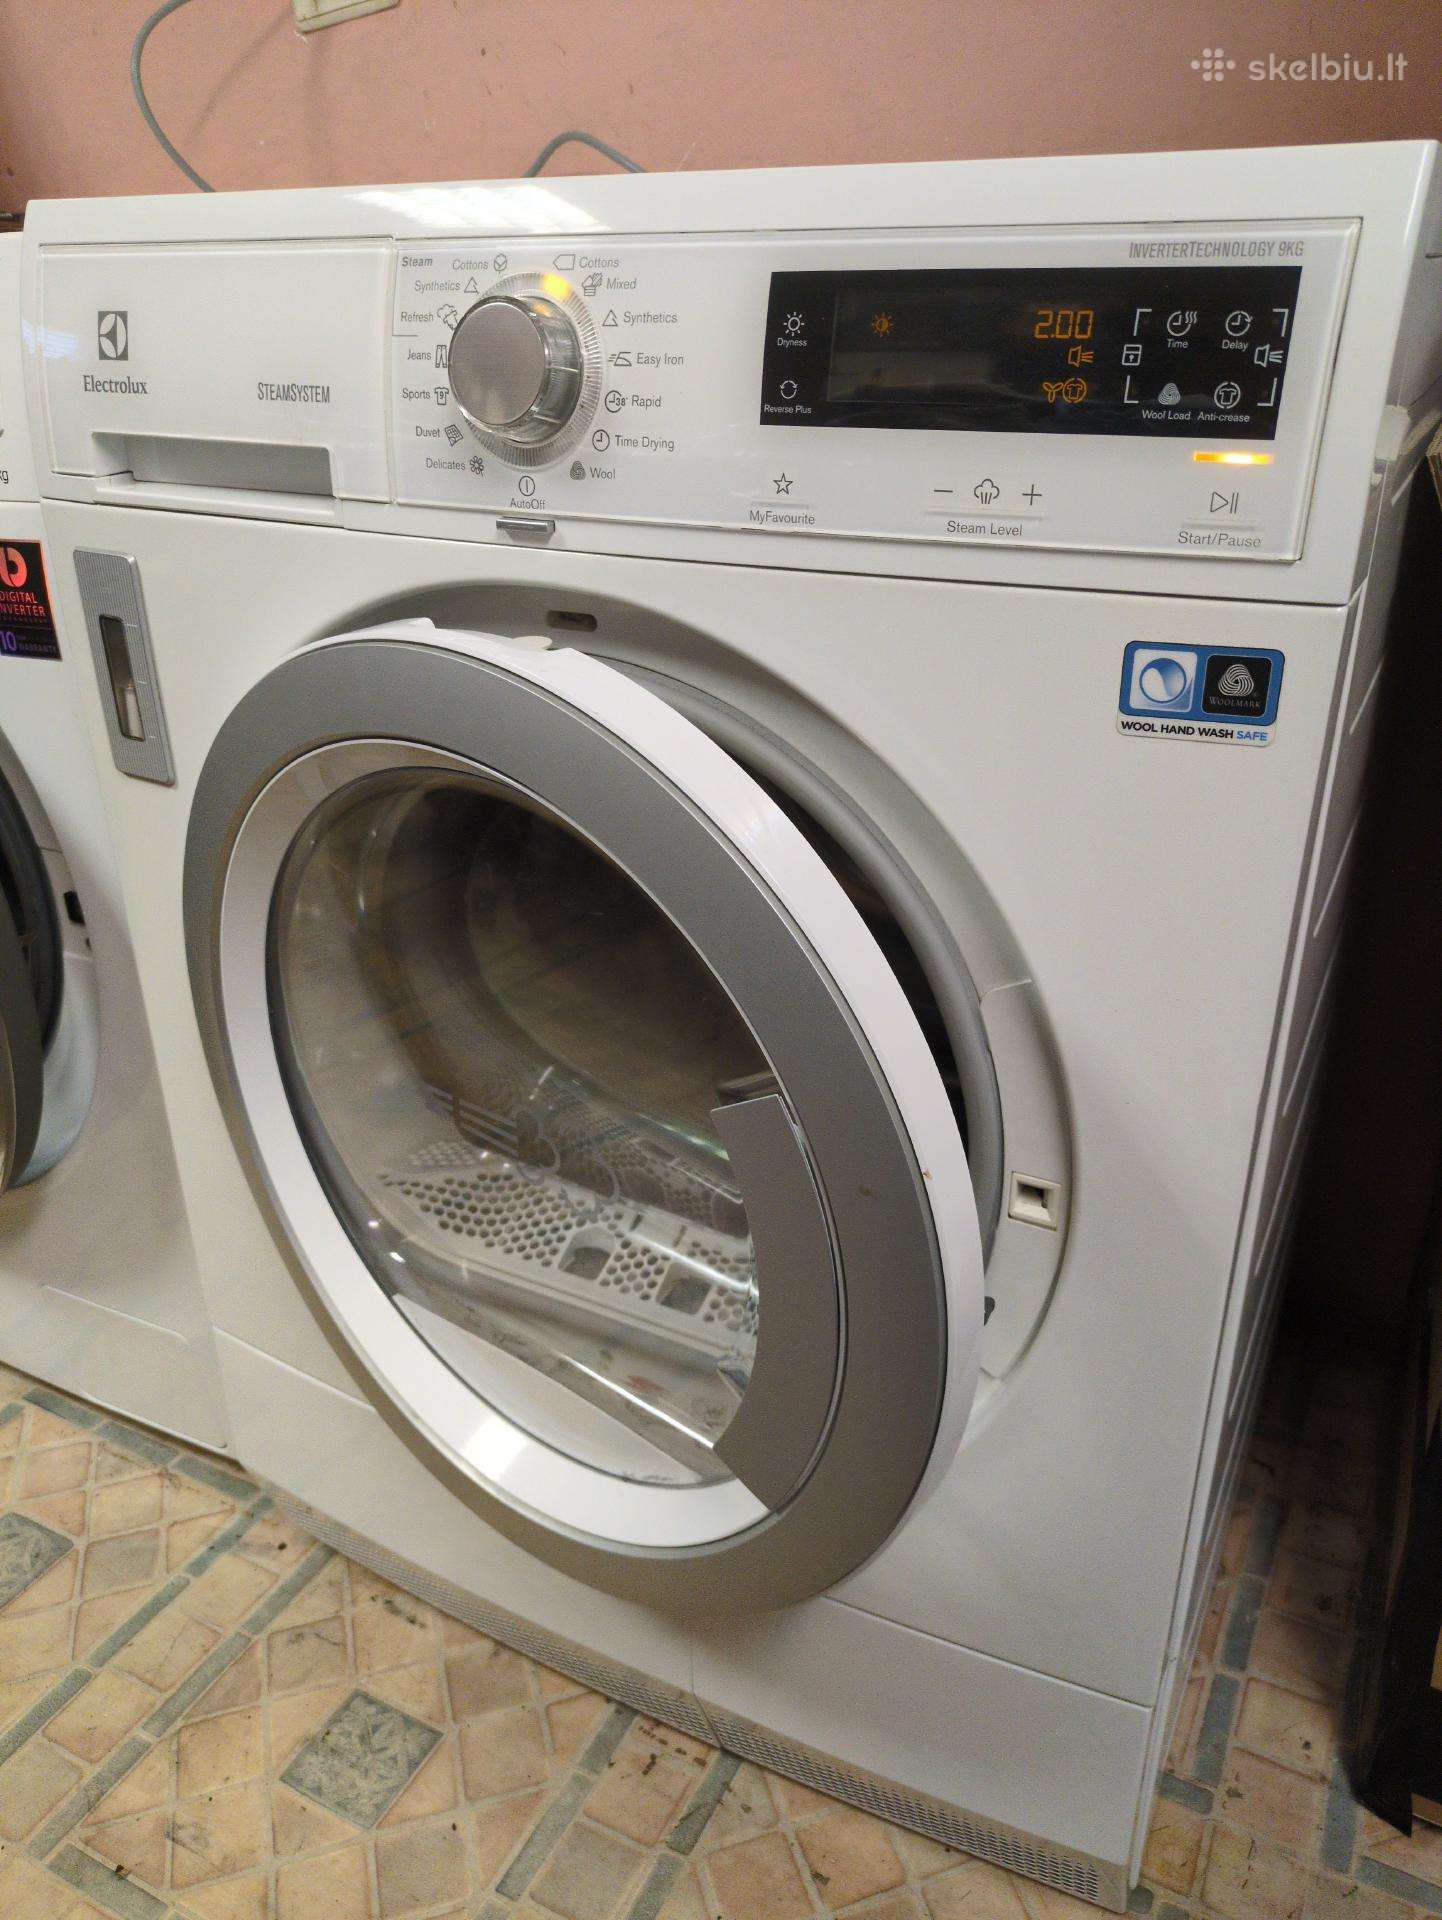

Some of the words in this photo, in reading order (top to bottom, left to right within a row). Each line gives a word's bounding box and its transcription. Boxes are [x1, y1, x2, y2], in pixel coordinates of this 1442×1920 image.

[401, 256, 433, 268] Steam
[452, 259, 489, 271] Cottons
[578, 257, 619, 269] Cottons
[414, 280, 460, 292] Synthetics
[606, 278, 637, 290] Mixed
[400, 311, 434, 323] Refresh
[623, 311, 678, 325] Synthetics
[777, 337, 807, 347] Dryness
[1167, 340, 1189, 349] Time
[1222, 340, 1249, 351] Delay
[407, 350, 432, 361] Jeans
[636, 353, 661, 366] Easy
[664, 353, 684, 365] Iron
[83, 374, 148, 395] Electrolux
[402, 388, 431, 400] Sports
[631, 394, 662, 411] Rapid
[764, 404, 794, 415] Reverse
[795, 405, 812, 414] Plus
[1142, 410, 1166, 420] Wool
[1168, 411, 1191, 421] Load
[1197, 412, 1250, 423] Anti-crease
[415, 426, 440, 438] Duvet
[614, 435, 639, 448] Time
[641, 437, 675, 452] Drying
[425, 458, 466, 471] Delicates
[590, 467, 616, 480] Wool
[510, 497, 546, 510] AutoOff
[749, 510, 815, 525] MyFavourite
[946, 521, 986, 535] Steam
[990, 523, 1023, 536] Level
[1178, 532, 1262, 548] Start/Pause
[0, 603, 46, 617] NVERTER
[1208, 696, 1262, 709] WOOLMARK
[1121, 721, 1159, 733] WOOL
[1160, 723, 1196, 737] HAND
[1198, 728, 1234, 740] WASH
[1236, 730, 1268, 742] SAFE
